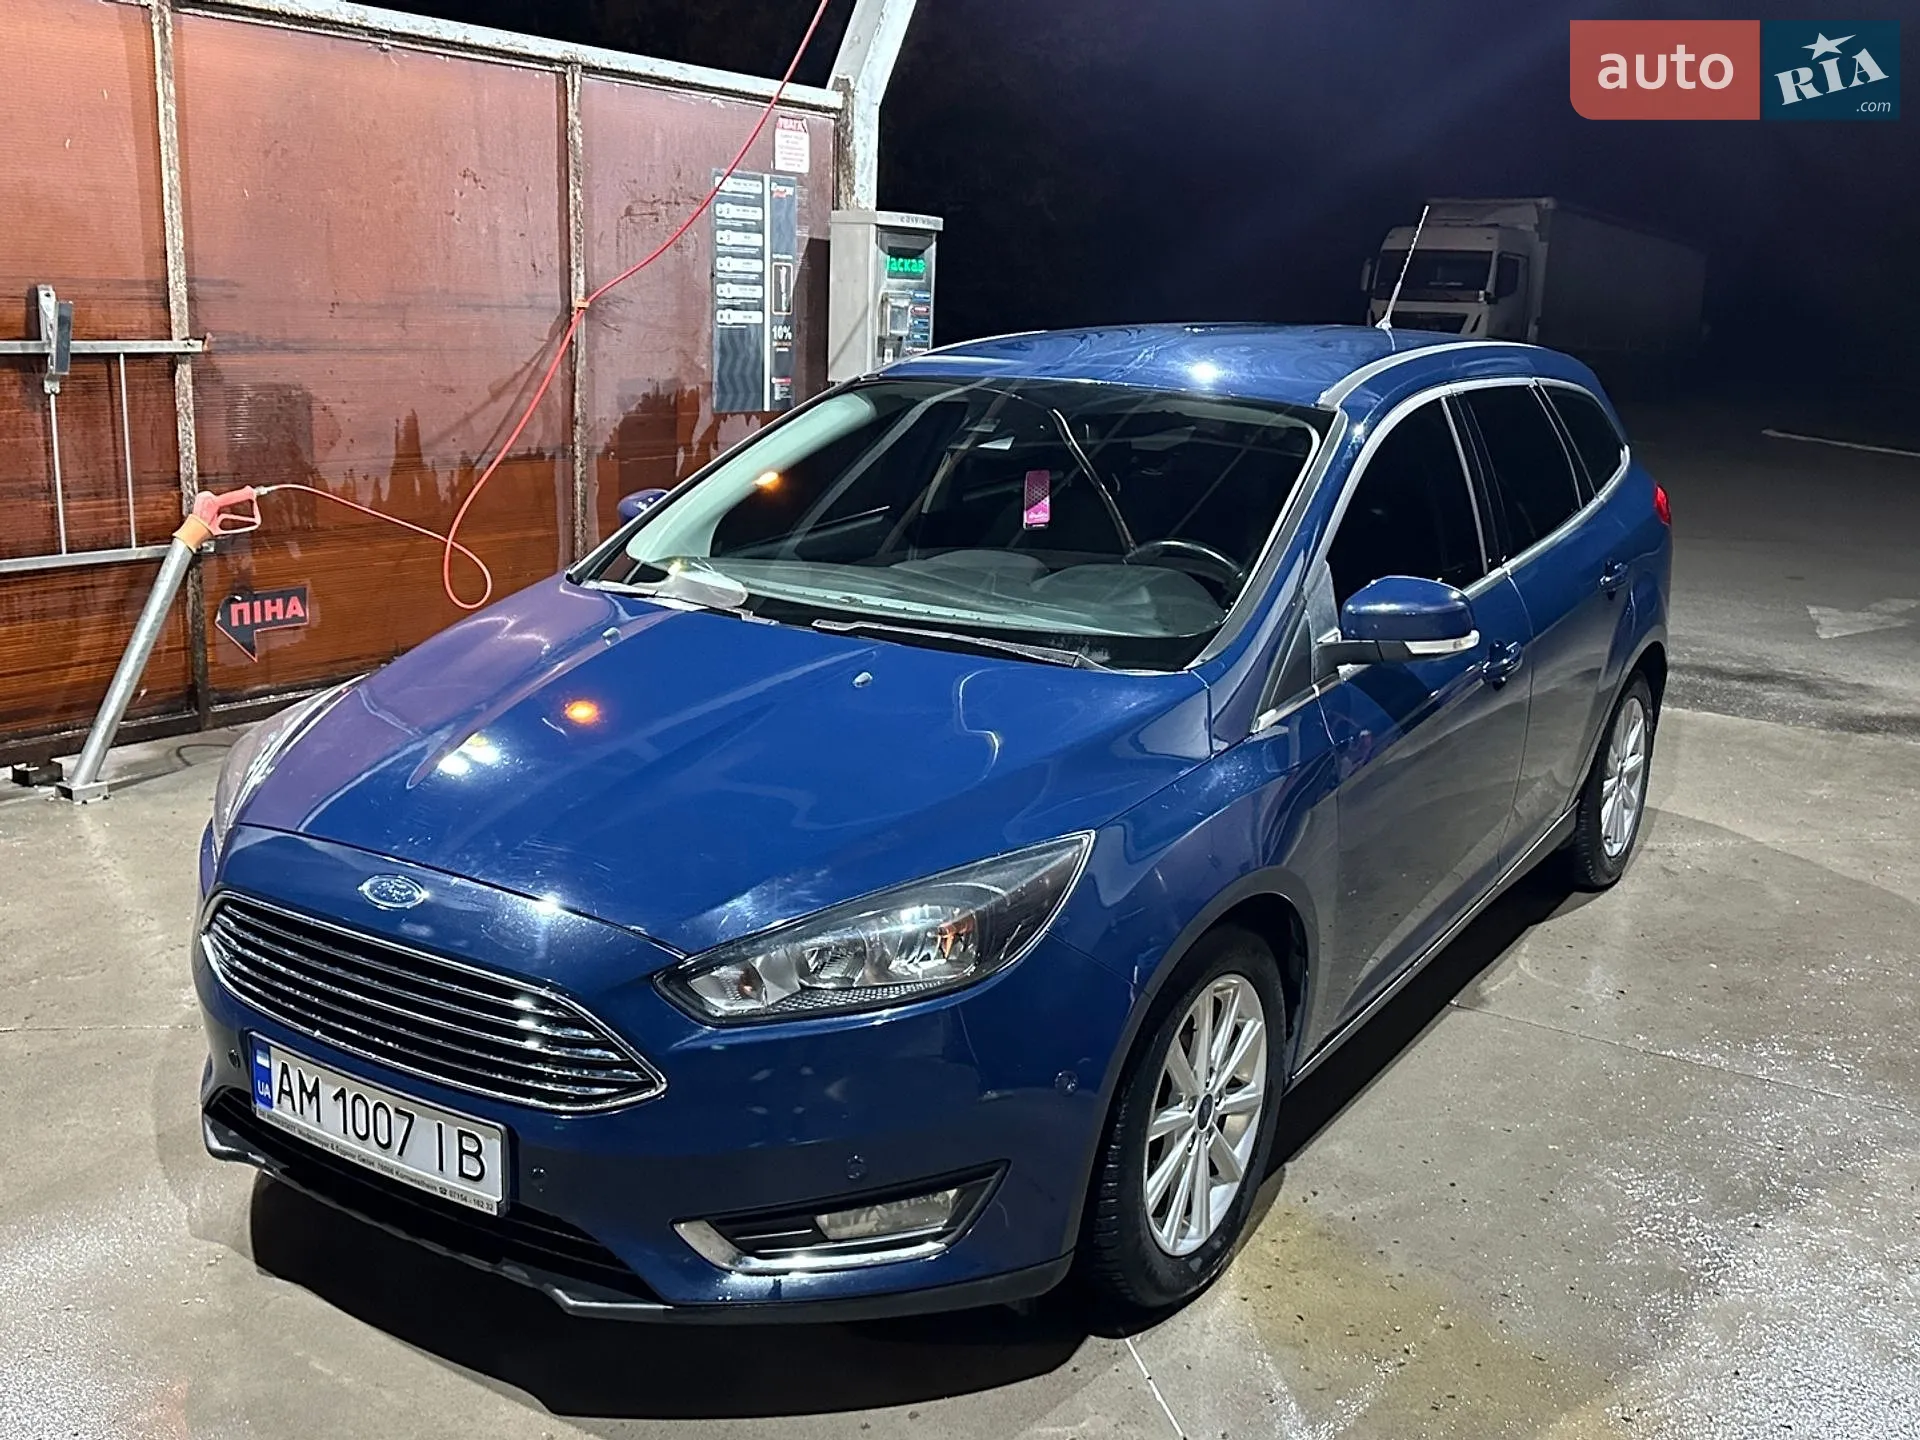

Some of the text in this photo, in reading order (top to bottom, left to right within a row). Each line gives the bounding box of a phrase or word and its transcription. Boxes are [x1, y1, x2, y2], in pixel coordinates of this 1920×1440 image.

[772, 325, 792, 340] 10%
[230, 596, 305, 627] ПІНА
[257, 1080, 271, 1099] UA
[277, 1061, 322, 1123] AM
[332, 1087, 416, 1157] 1007
[437, 1122, 486, 1182] IB
